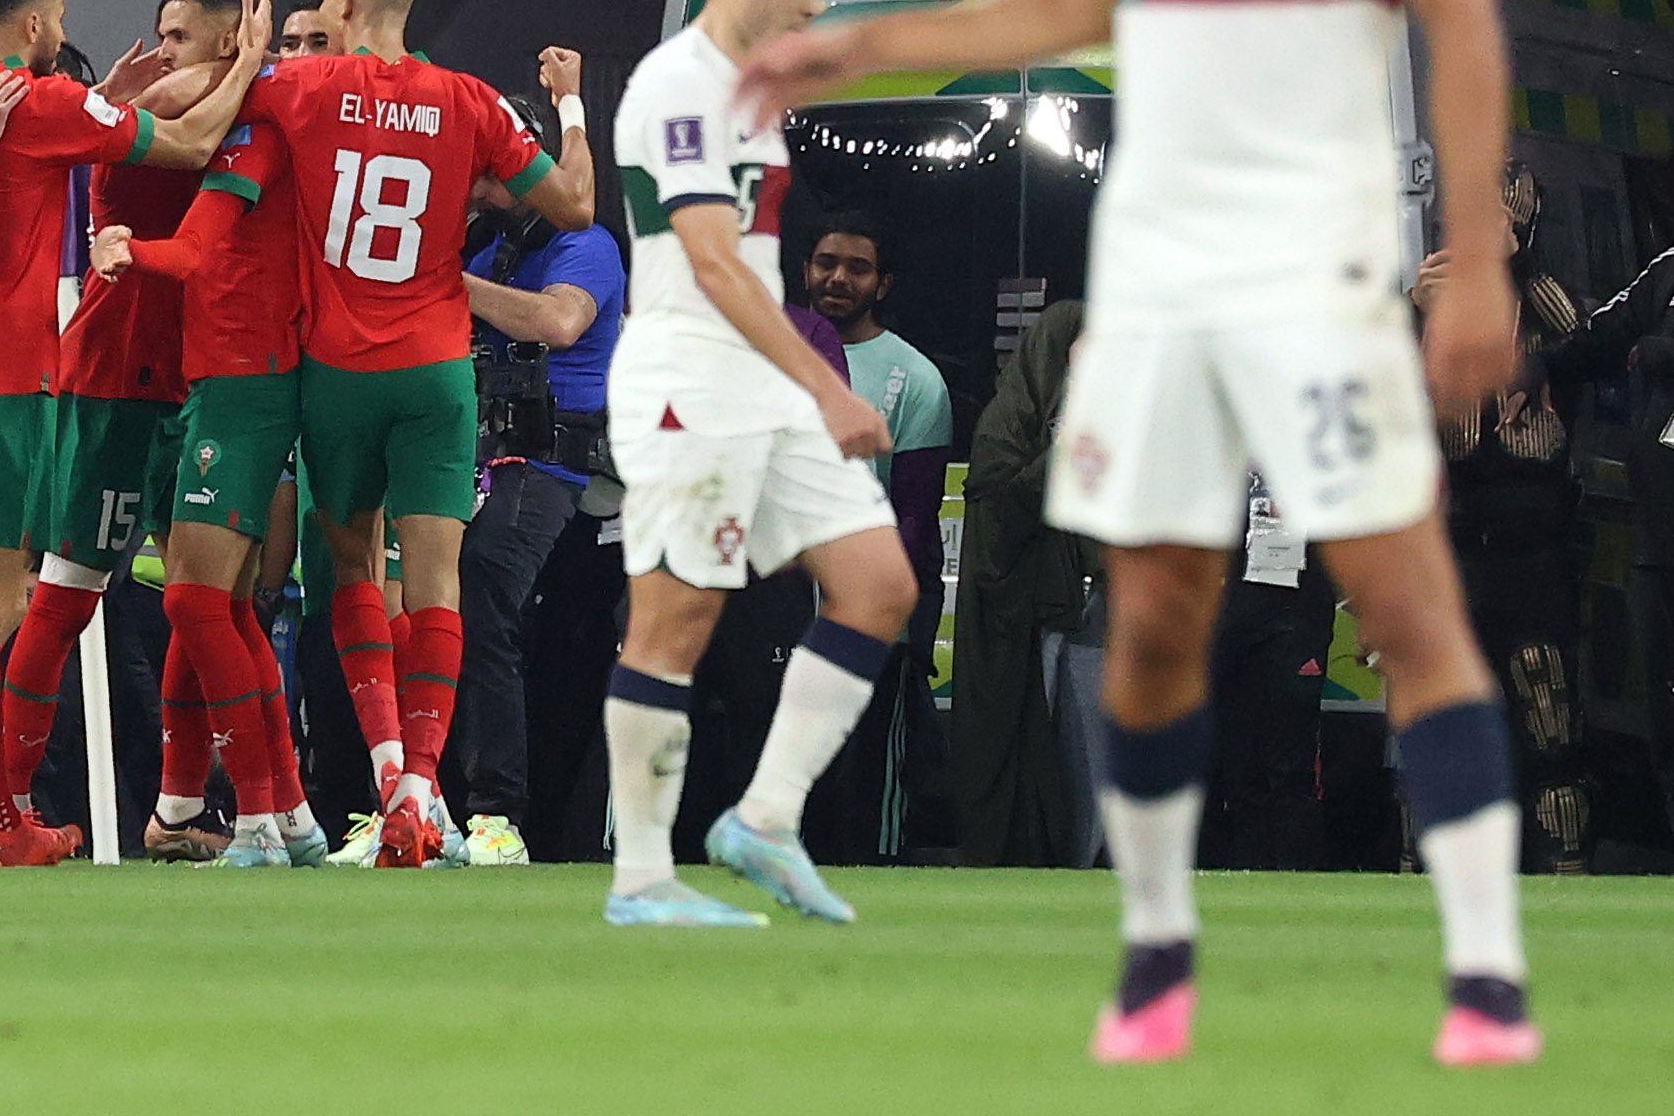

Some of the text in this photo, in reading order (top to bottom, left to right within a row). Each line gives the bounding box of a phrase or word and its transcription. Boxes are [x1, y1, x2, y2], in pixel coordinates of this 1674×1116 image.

[339, 92, 442, 138] EL-YAMIQ
[323, 147, 433, 284] 18
[96, 488, 142, 552] 15
